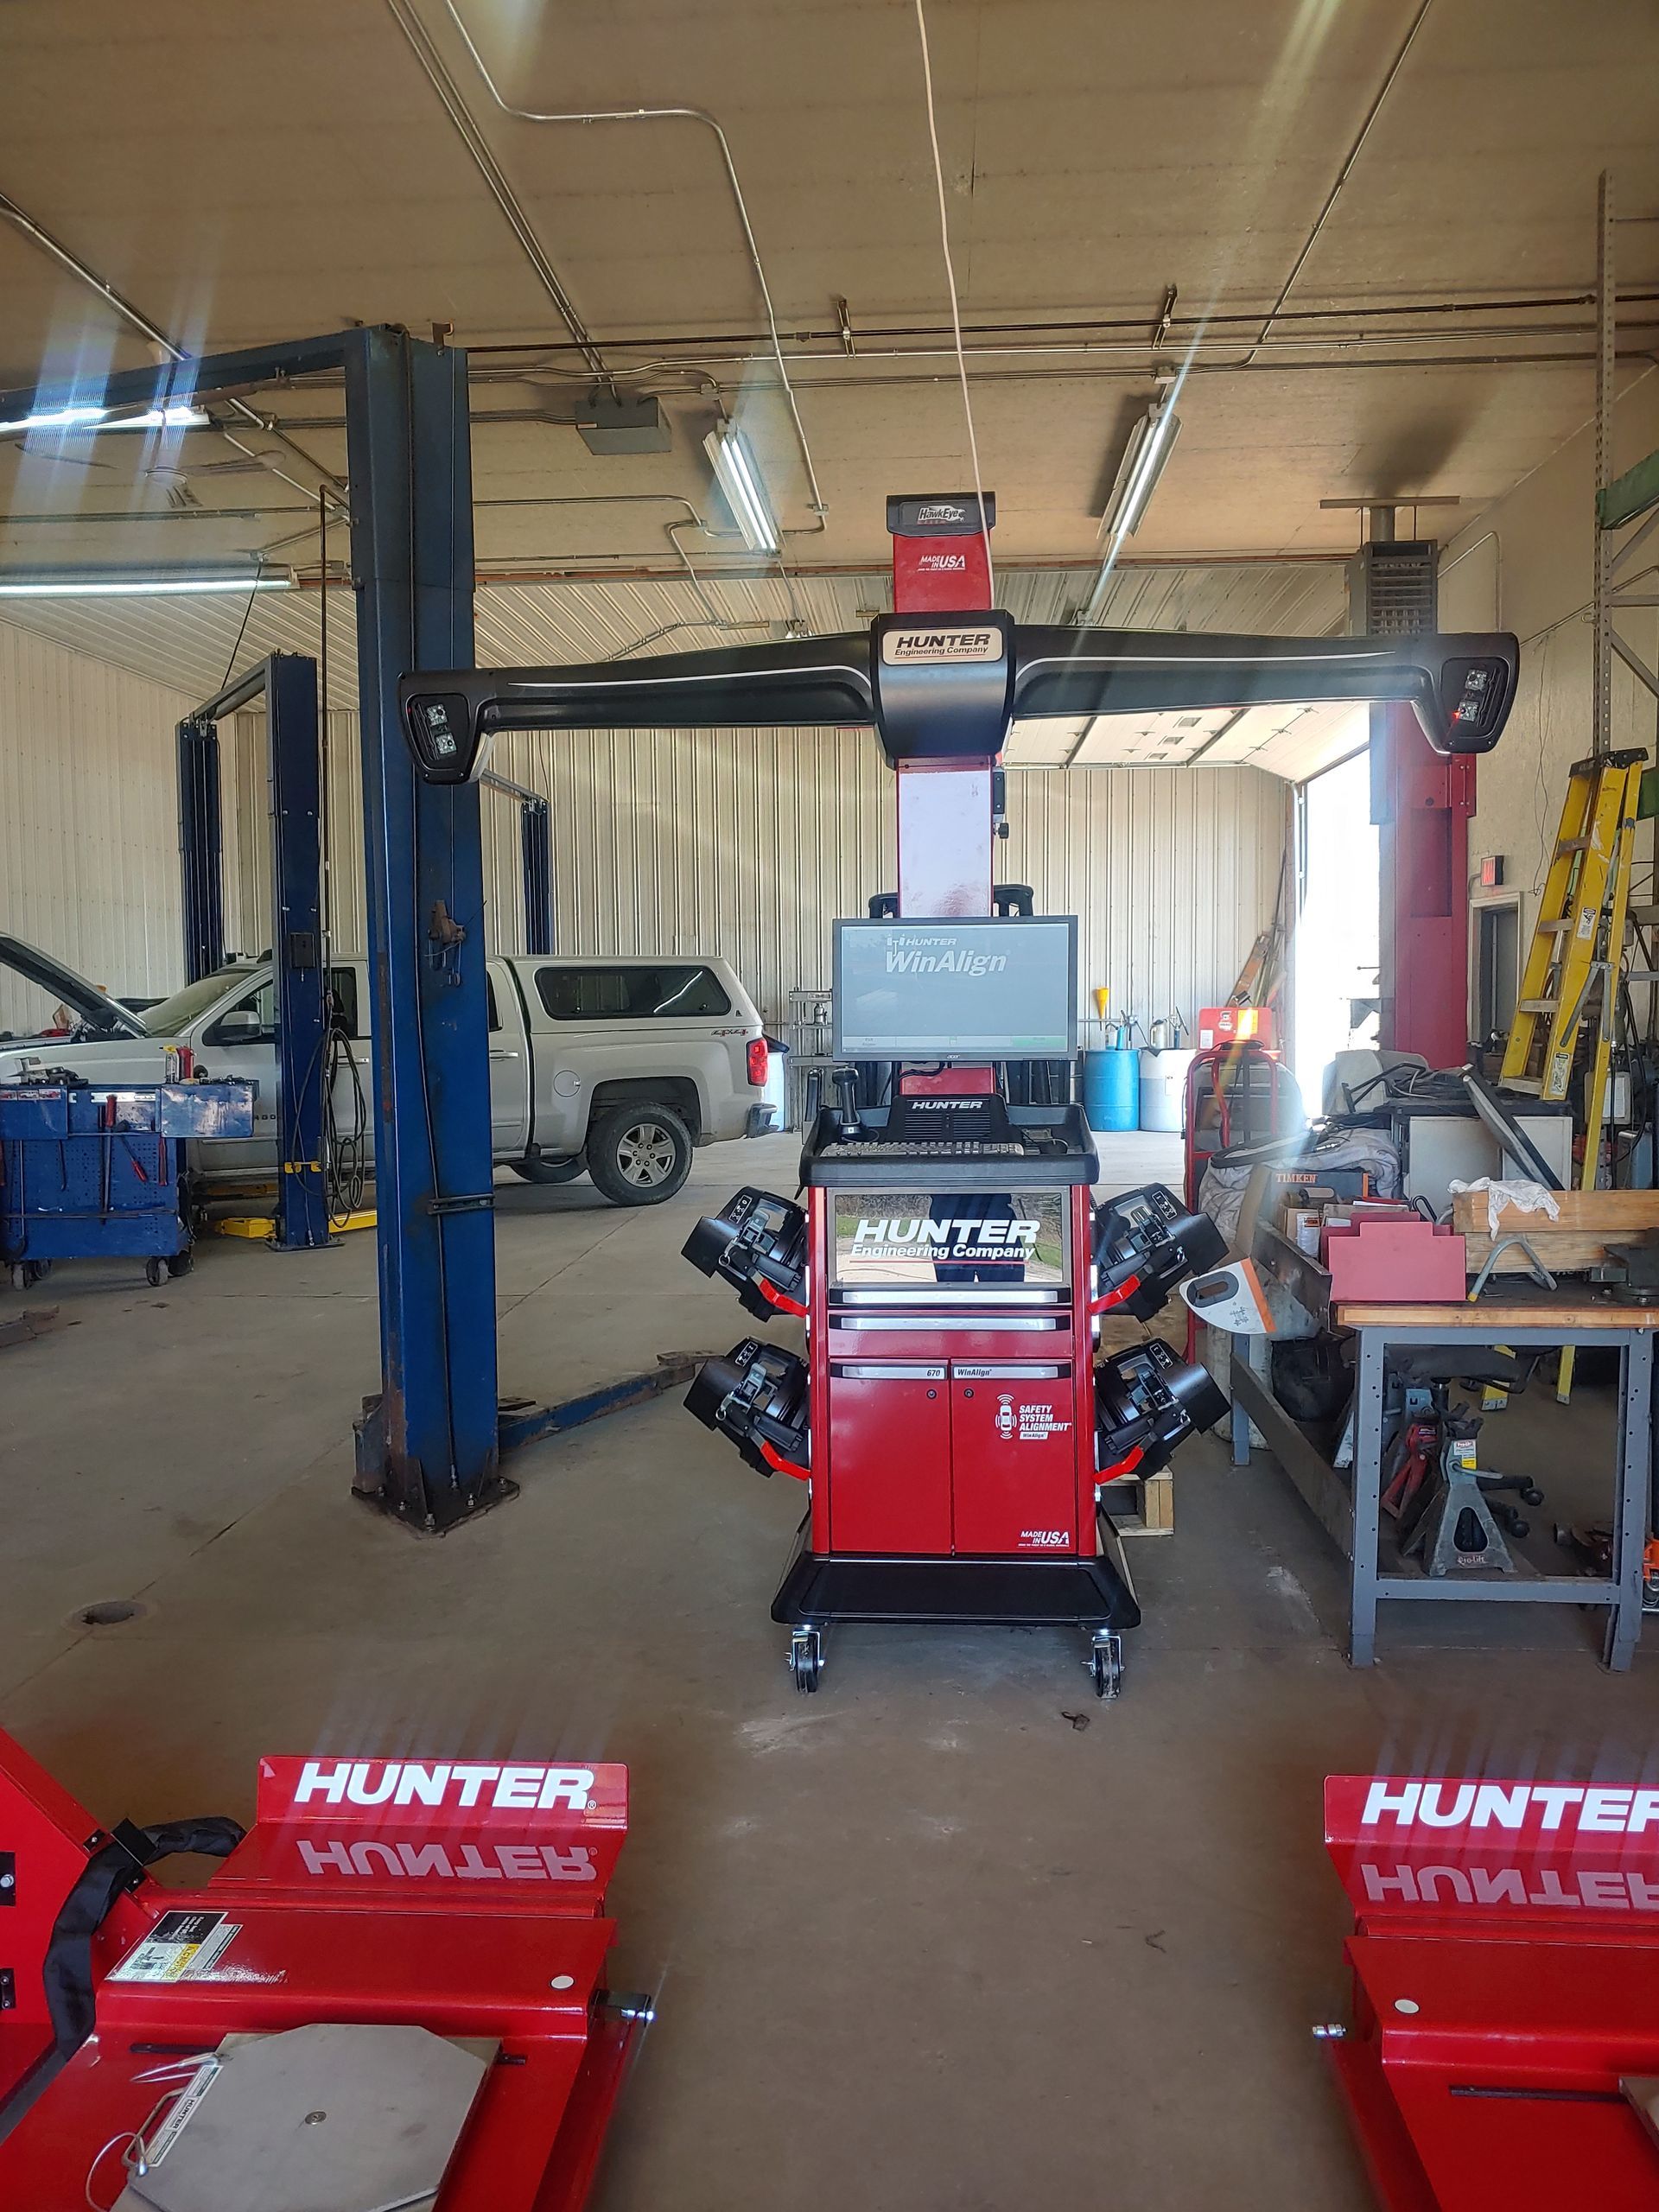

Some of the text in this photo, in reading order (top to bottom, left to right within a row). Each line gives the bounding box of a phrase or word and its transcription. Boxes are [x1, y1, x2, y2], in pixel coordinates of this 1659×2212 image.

[920, 506, 959, 519] HawkEye
[939, 555, 966, 569] USA
[897, 633, 991, 648] HUNTER
[894, 646, 988, 657] Engineering Company
[906, 938, 957, 946] HUNTER
[886, 950, 1007, 976] WinAlign
[912, 1101, 983, 1109] HUNTER
[1276, 1173, 1318, 1183] TIMKEN
[854, 1219, 1041, 1243] HUNTER
[851, 1243, 1036, 1260] Engineering Company
[1020, 1405, 1052, 1414] SAFETY
[1020, 1414, 1054, 1422] SYSTEM
[1020, 1422, 1070, 1432] ALIGNMENT
[1041, 1531, 1070, 1544] USA
[295, 1763, 595, 1810] HUNTER
